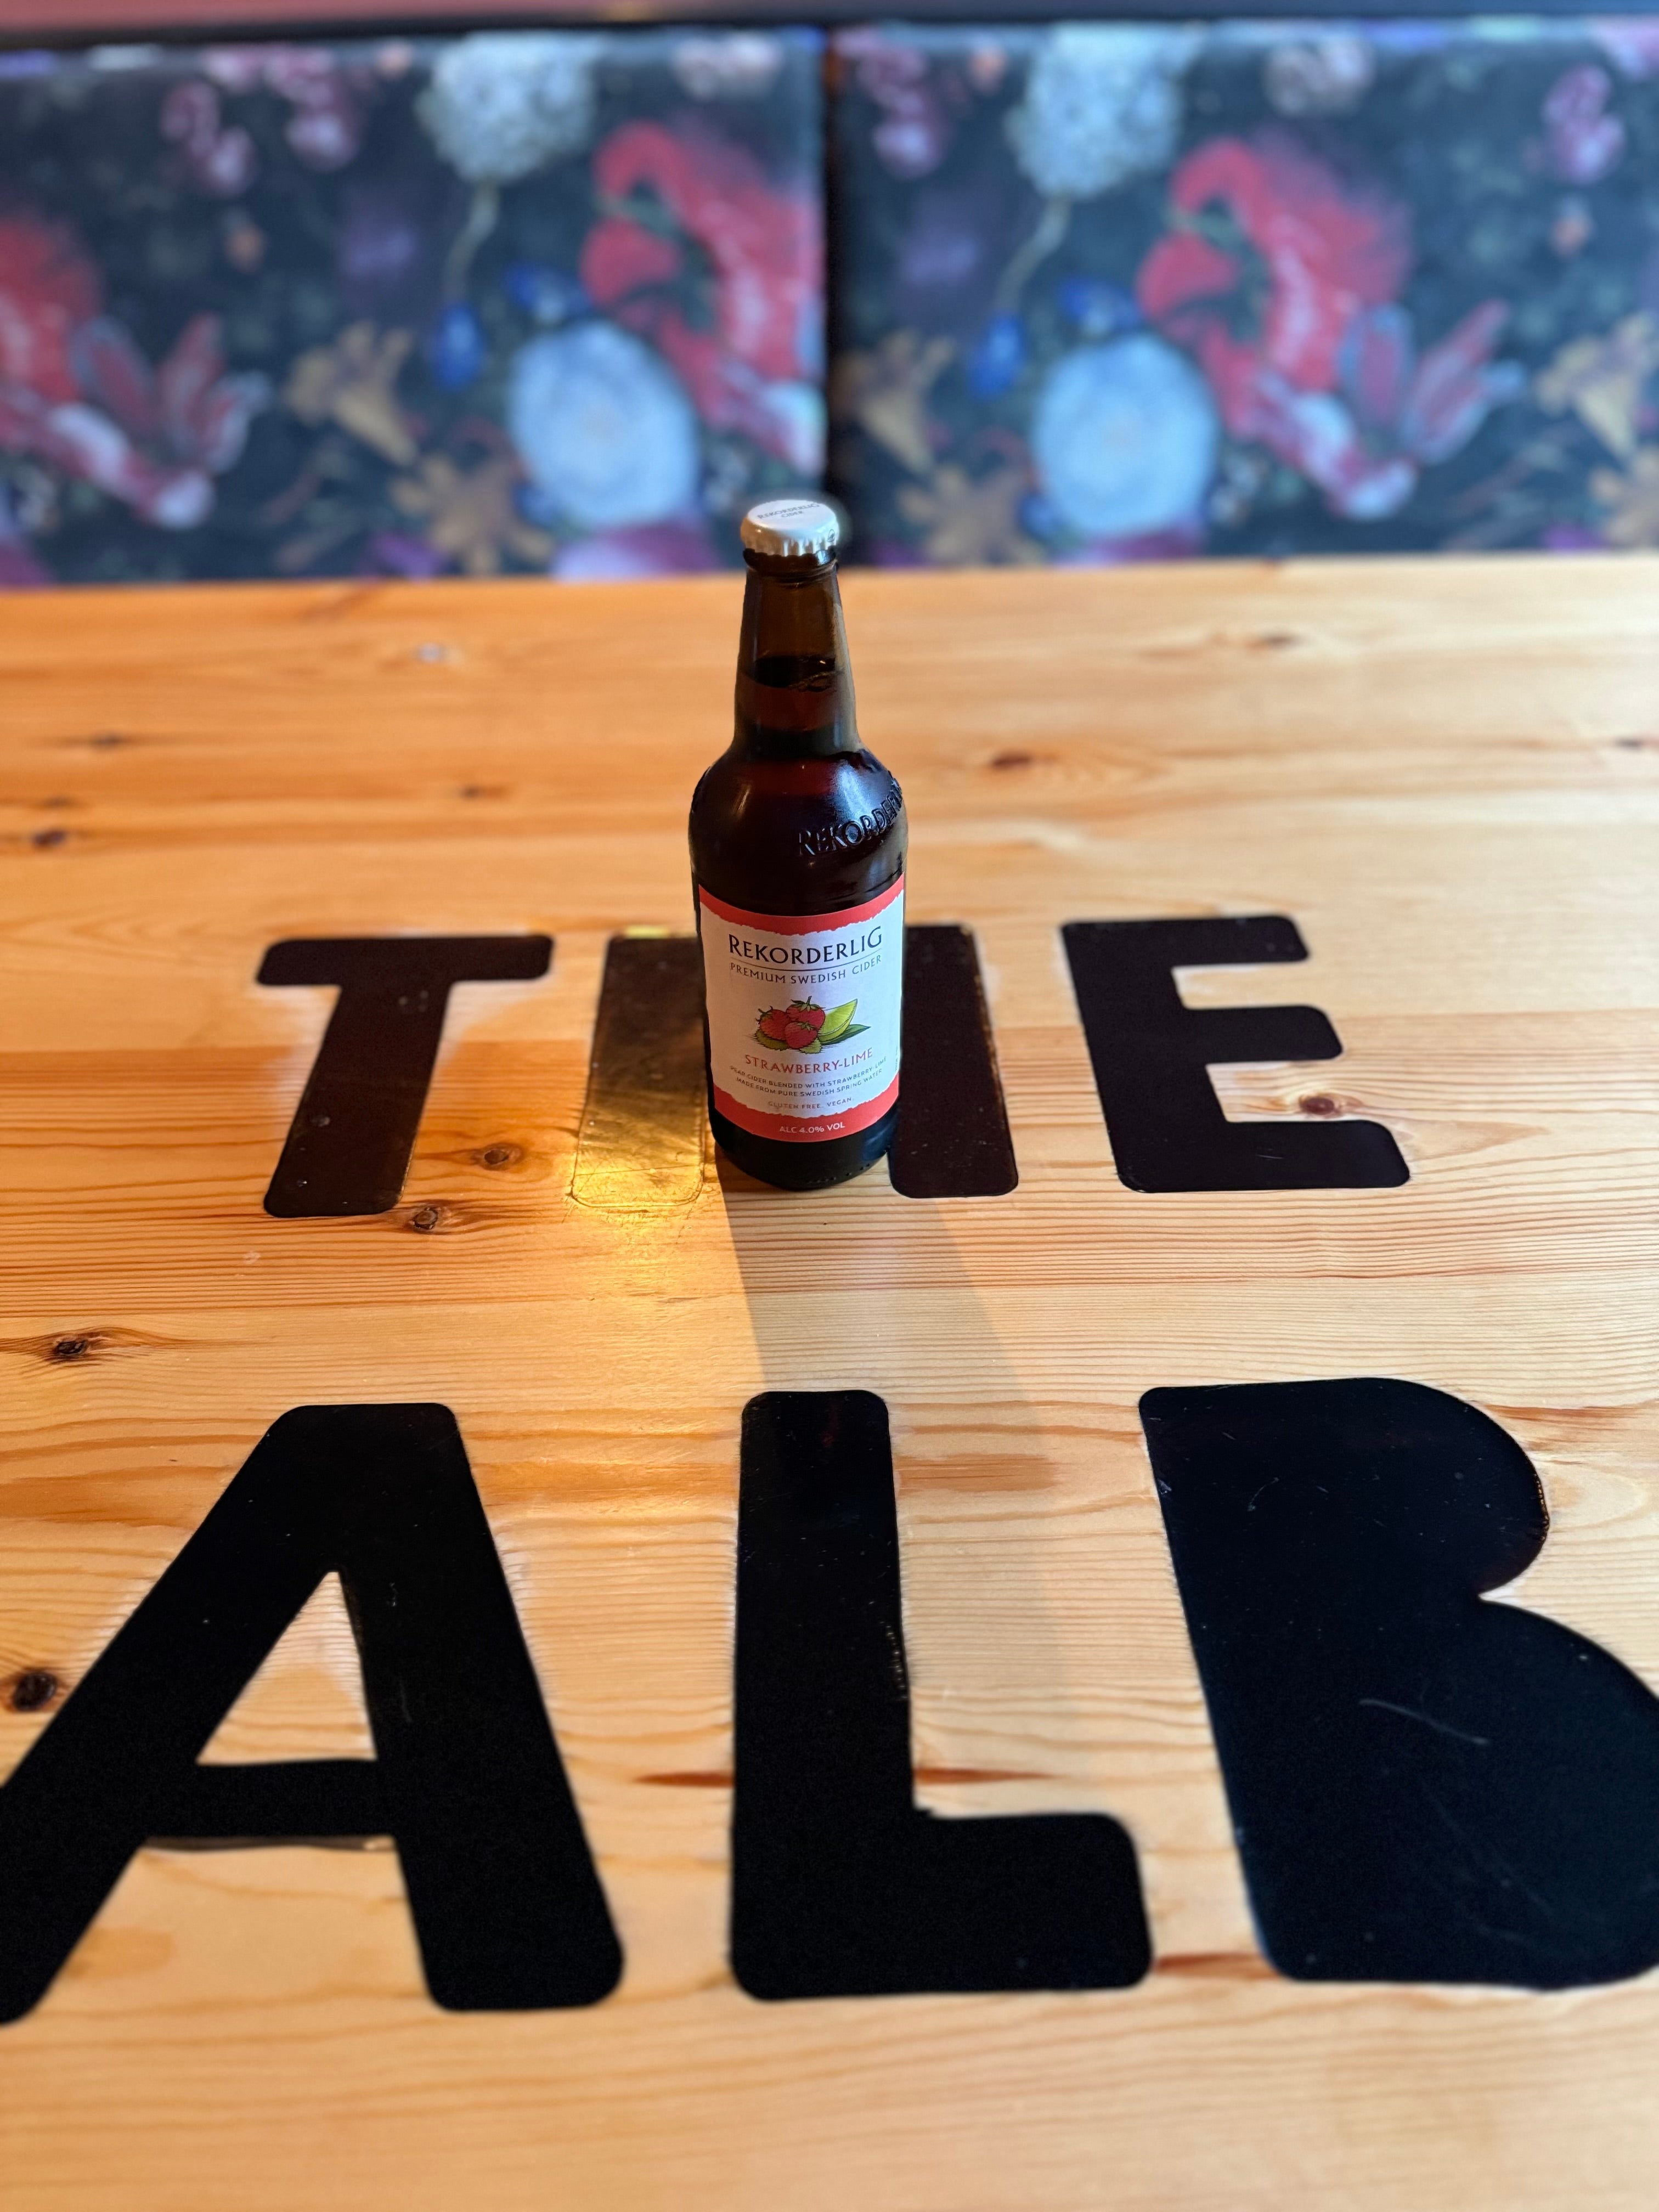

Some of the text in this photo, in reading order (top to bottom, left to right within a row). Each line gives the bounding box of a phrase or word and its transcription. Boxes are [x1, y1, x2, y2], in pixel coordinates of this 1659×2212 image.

[757, 503, 820, 519] REKORDERLIG
[729, 926, 882, 964] REKORDERLIG
[730, 955, 882, 984] PREMIUM SWEDISH CIDER
[744, 1047, 873, 1074] STRAWBERRY-LIME
[730, 1065, 746, 1076] PEAR
[747, 1074, 766, 1084] CIDER
[769, 1080, 803, 1089] BLENDED
[737, 1077, 754, 1088] MADE
[756, 1085, 776, 1094] FROM
[837, 1080, 862, 1093] SPRING
[863, 1068, 882, 1083] WATER
[826, 1122, 845, 1131] VOL
